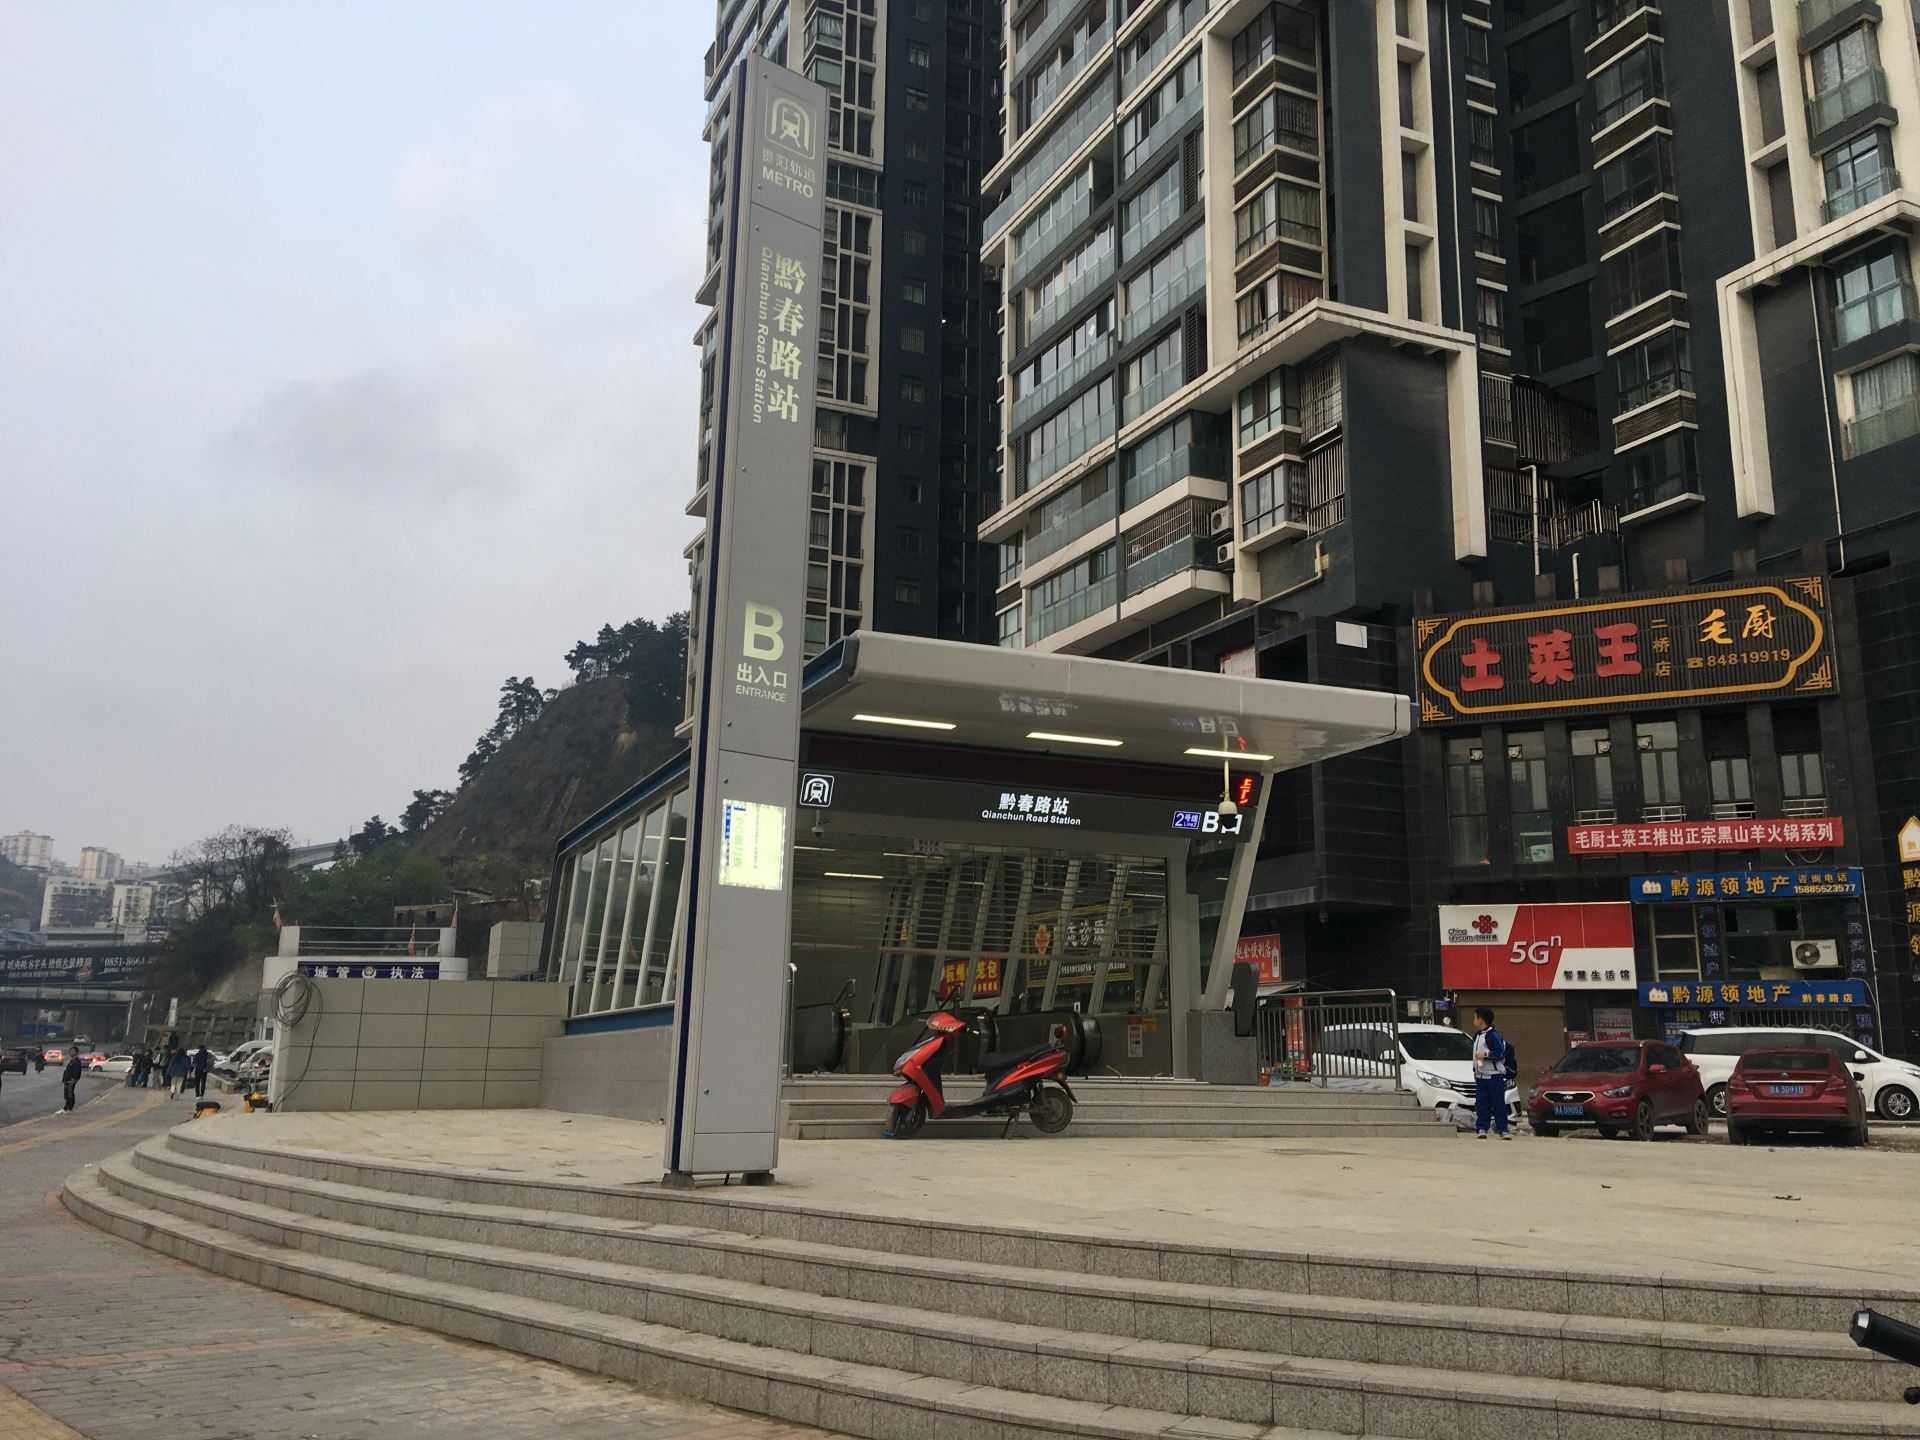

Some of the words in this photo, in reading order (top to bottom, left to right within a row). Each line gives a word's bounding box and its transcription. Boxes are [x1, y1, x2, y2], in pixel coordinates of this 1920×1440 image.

[763, 165, 814, 198] METRO
[760, 247, 773, 320] Qianchun
[757, 322, 769, 364] Road
[767, 252, 807, 423] 黔春路站
[754, 367, 767, 424] Station
[743, 600, 784, 661] B
[1698, 603, 1777, 646] 毛厨
[1460, 622, 1643, 693] 土菜王
[1650, 618, 1673, 679] 二桥店
[1707, 647, 1791, 669] 84819919
[736, 662, 787, 689] 出入口
[735, 684, 786, 703] ENTRANCE
[999, 793, 1070, 816] 黔春路站
[981, 810, 1025, 821] Qianchun
[1025, 813, 1049, 823] Road
[1050, 815, 1081, 826] Station
[1174, 812, 1199, 827] 2号线
[1575, 820, 1834, 849] 毛厨土菜王推出正宗黑山羊火锅系列
[1671, 876, 1790, 897] 黔源领地产
[1794, 883, 1856, 894] 15885523577
[1798, 872, 1847, 884] 咨询电话
[1448, 928, 1467, 936] China
[946, 960, 998, 983] 杭州笼包
[1563, 969, 1631, 981] 智慧生活馆
[1672, 985, 1791, 1004] 黔源领地产
[1802, 993, 1853, 1004] 黔春路店
